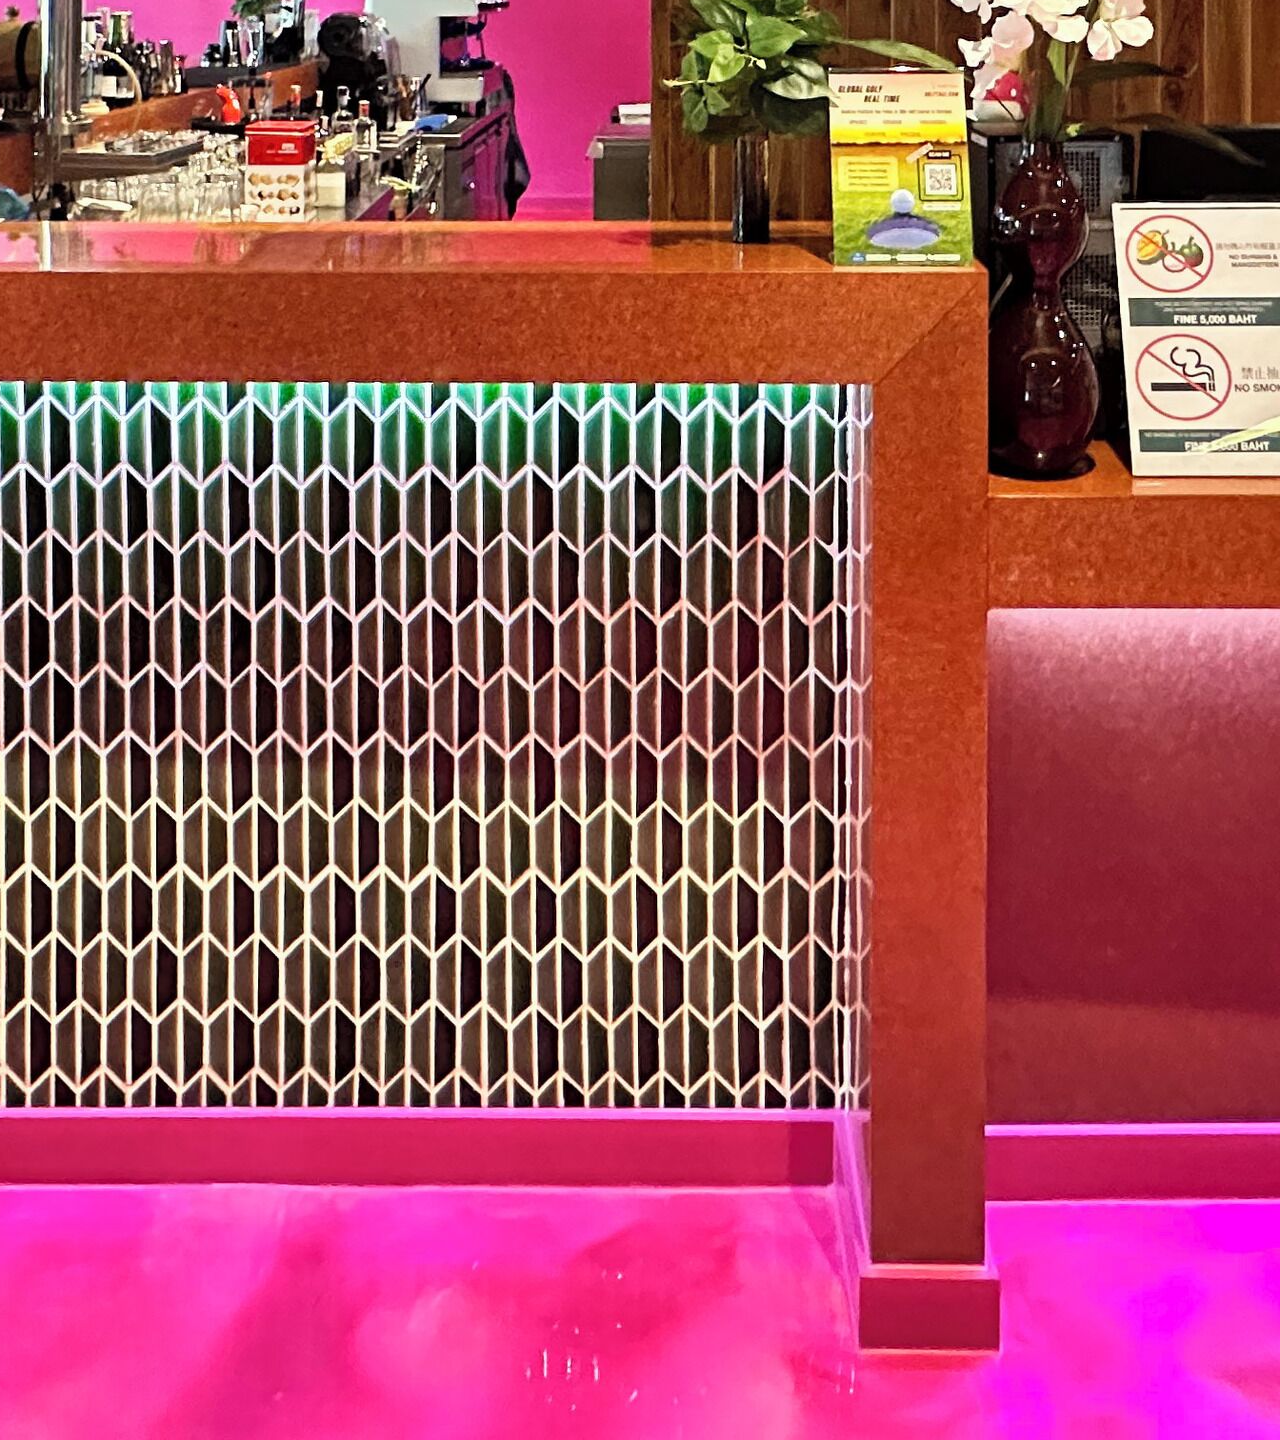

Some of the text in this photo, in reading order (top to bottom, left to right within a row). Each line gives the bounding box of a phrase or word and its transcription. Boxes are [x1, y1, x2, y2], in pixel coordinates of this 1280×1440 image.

[837, 85, 863, 93] GLOBAL
[863, 95, 900, 103] REAL TIME
[1173, 314, 1258, 325] FINE 5,000 BAHT
[1234, 383, 1250, 392] NO
[1241, 441, 1270, 450] BAHT
